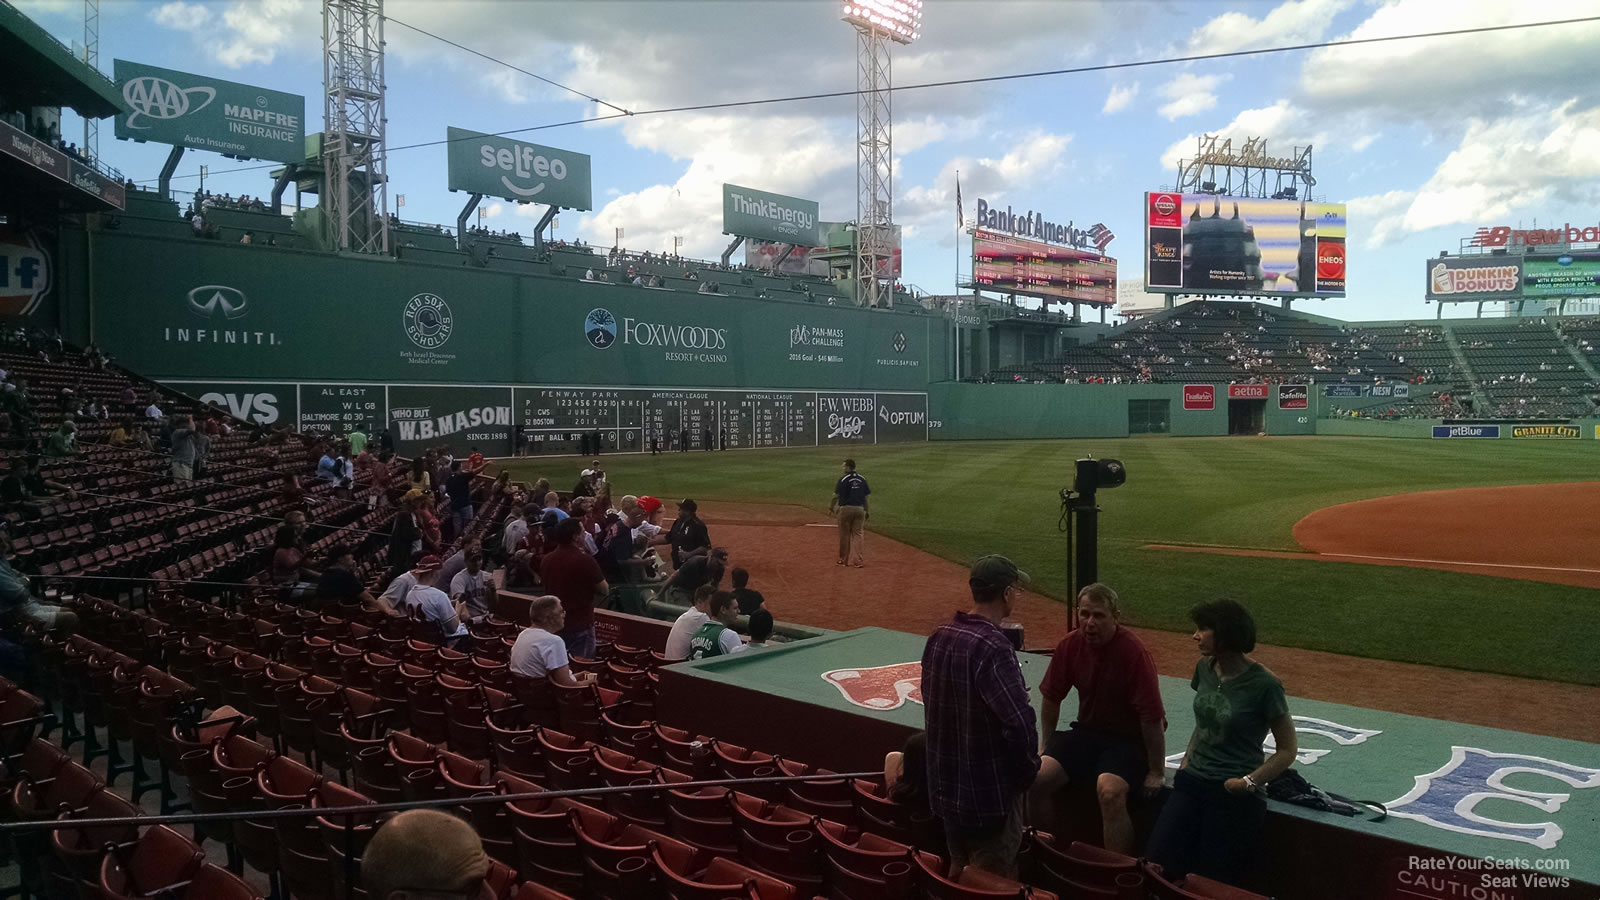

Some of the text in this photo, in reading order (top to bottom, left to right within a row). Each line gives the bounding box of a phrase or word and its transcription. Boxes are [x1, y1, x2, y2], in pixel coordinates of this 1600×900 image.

[131, 79, 183, 119] AAA
[224, 103, 298, 128] MAPFRE
[229, 121, 295, 143] INSURANCE
[184, 134, 246, 151] Auto Insurance
[1236, 136, 1317, 186] Hancock
[730, 193, 813, 230] ThinkEnergy
[978, 198, 1087, 249] Bank of America
[1512, 228, 1562, 246] new
[1319, 256, 1344, 264] ENEOS
[1456, 267, 1518, 281] DUNKIN'
[1456, 279, 1514, 291] DONUTS
[406, 296, 444, 318] RED SOX
[165, 327, 275, 345] INFINITI
[408, 317, 450, 346] SCHOLARS
[623, 317, 726, 350] FOXWOODS
[812, 327, 844, 338] PAN-MASS
[812, 337, 844, 348] CHALLENGE
[665, 352, 727, 363] RESORT CASINO
[1234, 386, 1263, 396] aetna
[342, 402, 376, 410] W L GB
[841, 398, 874, 412] WEBB
[302, 413, 364, 422] BALTIMORE 40 30
[392, 408, 430, 419] WHO BUT
[890, 412, 925, 425] OPTUM
[302, 423, 331, 432] BOSTON
[1449, 426, 1482, 438] jetBlue
[1514, 426, 1556, 436] GRANITE
[1558, 426, 1578, 436] CITY
[594, 620, 621, 631] CAUTION!
[691, 636, 713, 651] THOMAS
